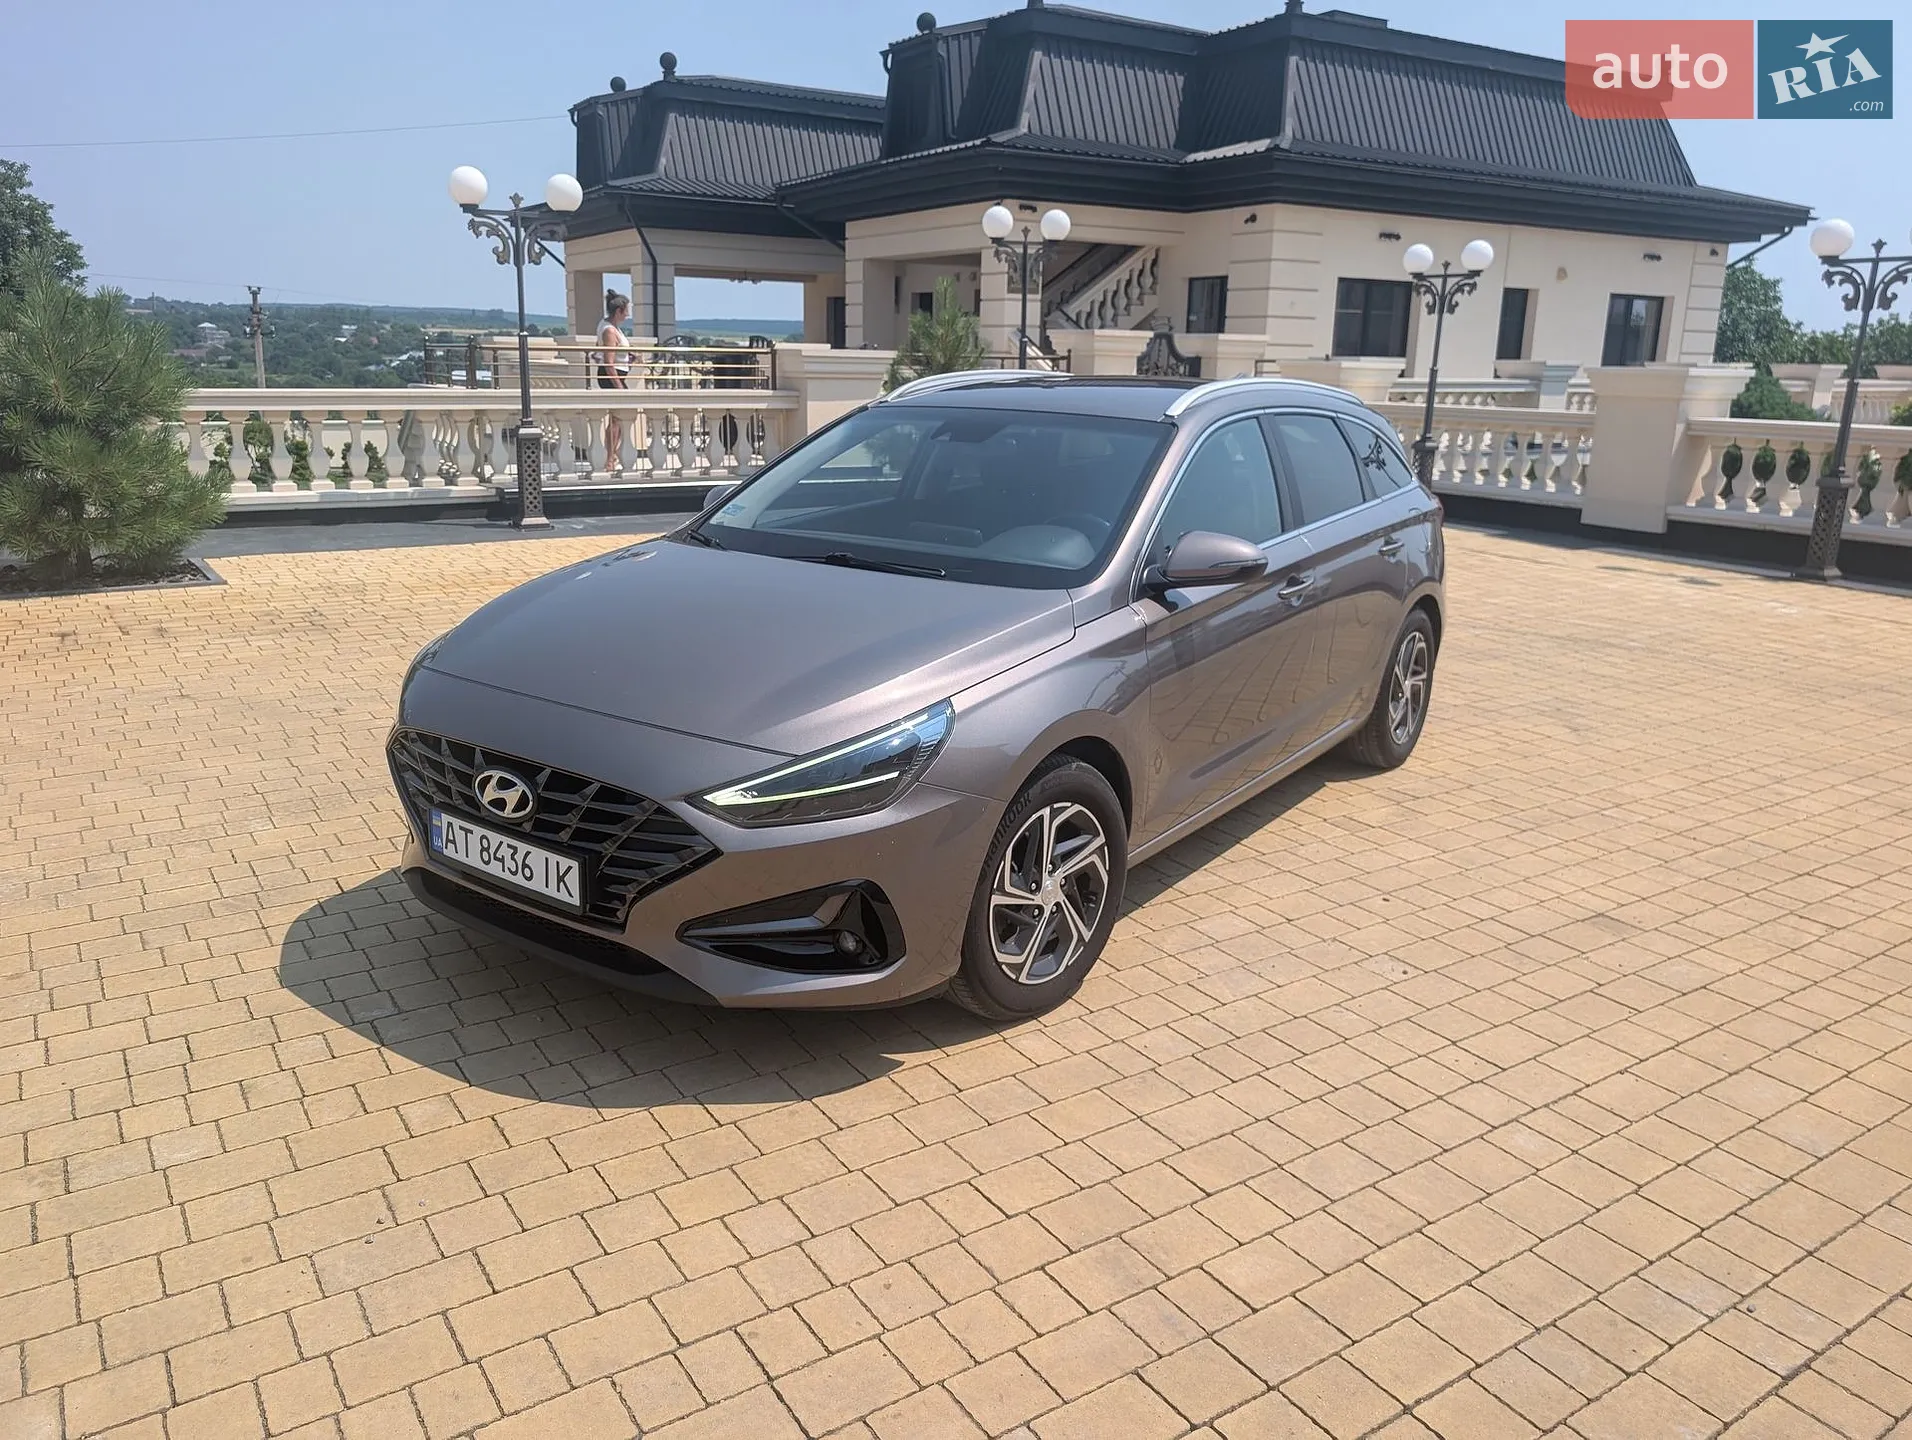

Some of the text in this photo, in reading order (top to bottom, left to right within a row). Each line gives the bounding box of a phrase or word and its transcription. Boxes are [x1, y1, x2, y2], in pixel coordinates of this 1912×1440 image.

[433, 836, 443, 848] UA
[444, 821, 574, 898] AT 8436 IK
